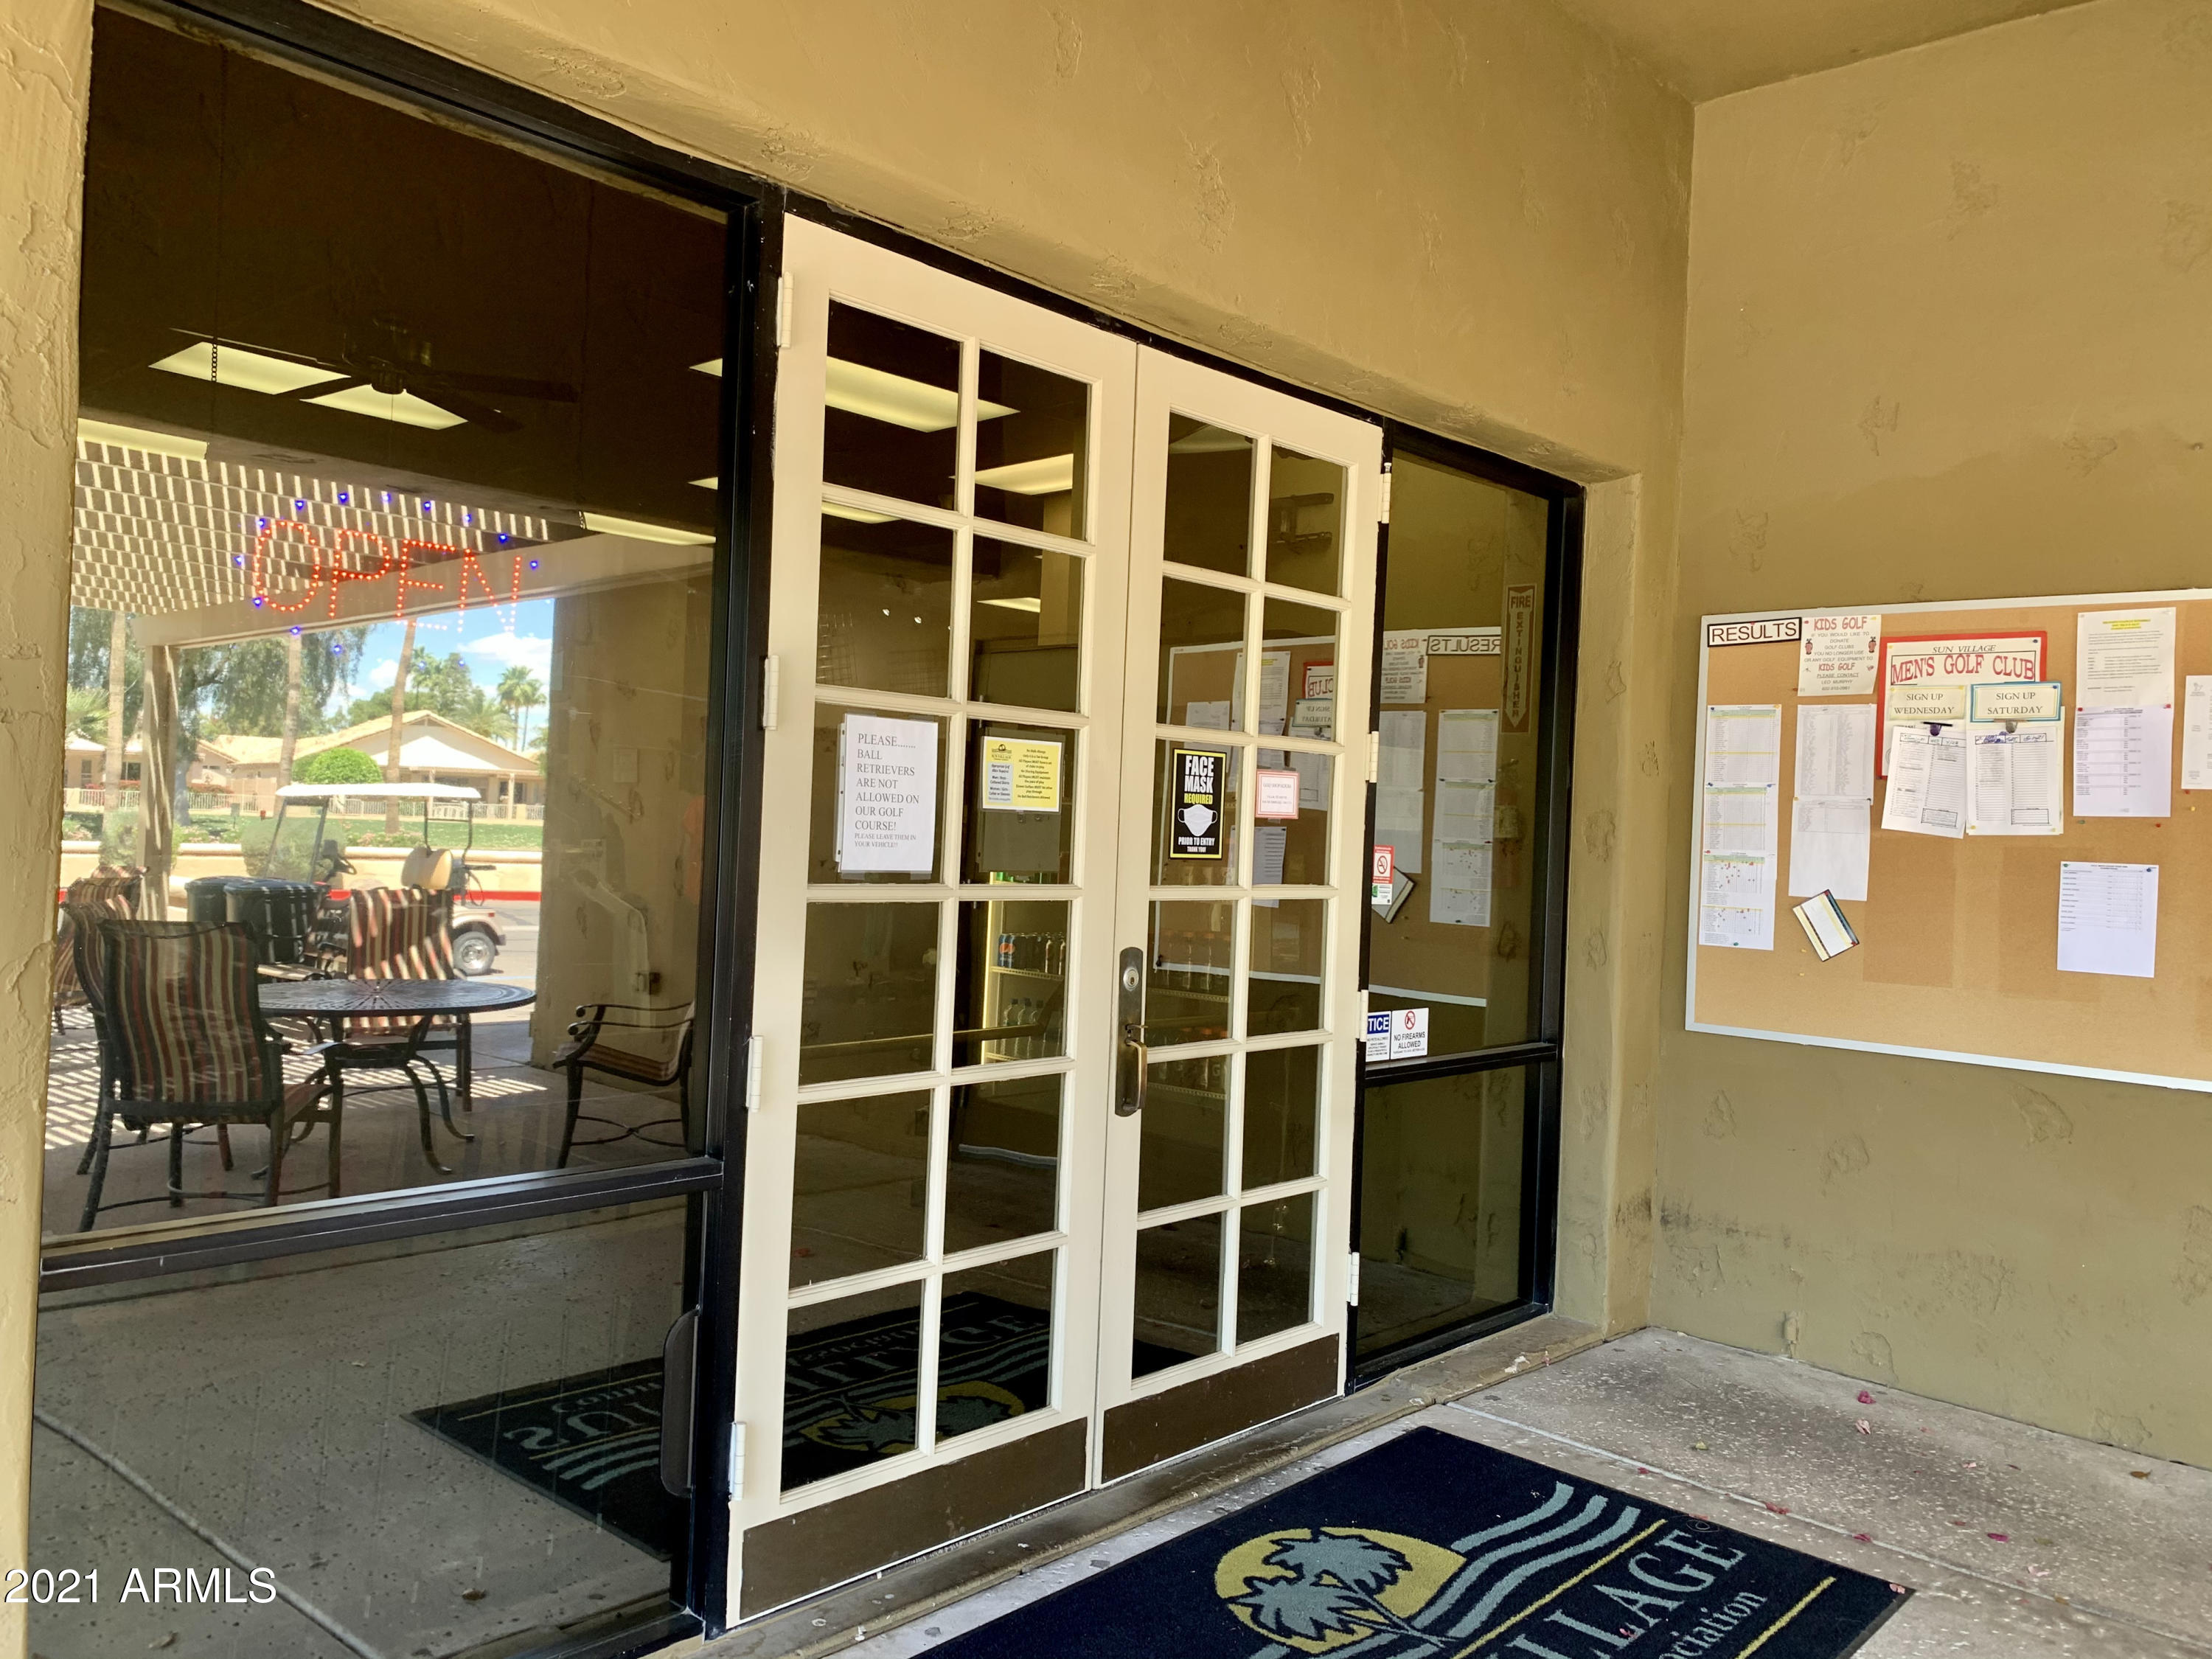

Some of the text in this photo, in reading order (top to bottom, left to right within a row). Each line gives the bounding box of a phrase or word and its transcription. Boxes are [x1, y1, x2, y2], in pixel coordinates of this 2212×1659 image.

[254, 519, 523, 634] OPEN
[1511, 595, 1531, 609] FIRE
[1814, 616, 1868, 631] KIDS GOLF
[1711, 621, 1797, 643] RESULTS
[1932, 644, 1997, 654] SUN VILLAGE
[1512, 611, 1525, 717] EXTINGUISHER
[1818, 662, 1856, 672] KIDS GOLF
[1891, 653, 2035, 684] MEN'S GOLF CLUB
[1906, 692, 1944, 701] SIGN UP
[1995, 692, 2036, 700] SIGN UP
[1893, 706, 1955, 714] WEDNESDAY
[1987, 706, 2043, 714] SATURDAY
[857, 748, 883, 760] BALL
[856, 763, 915, 776] RETRIEVERS
[1185, 754, 1215, 776] FACE
[856, 778, 898, 789] ARE NOT
[1183, 775, 1214, 794] MASK
[855, 792, 919, 804] ALLOWED ON
[1183, 793, 1214, 805] REQUIRED
[855, 806, 904, 817] OUR GOLF
[855, 820, 897, 831] COURSE!
[1178, 836, 1215, 846] PRIOR TO ENTRY
[1368, 1017, 1390, 1032] TICE
[1402, 1031, 1426, 1040] FIREARMS
[1397, 1040, 1422, 1049] ALLOWED
[1484, 1528, 1747, 1659] LLAGE
